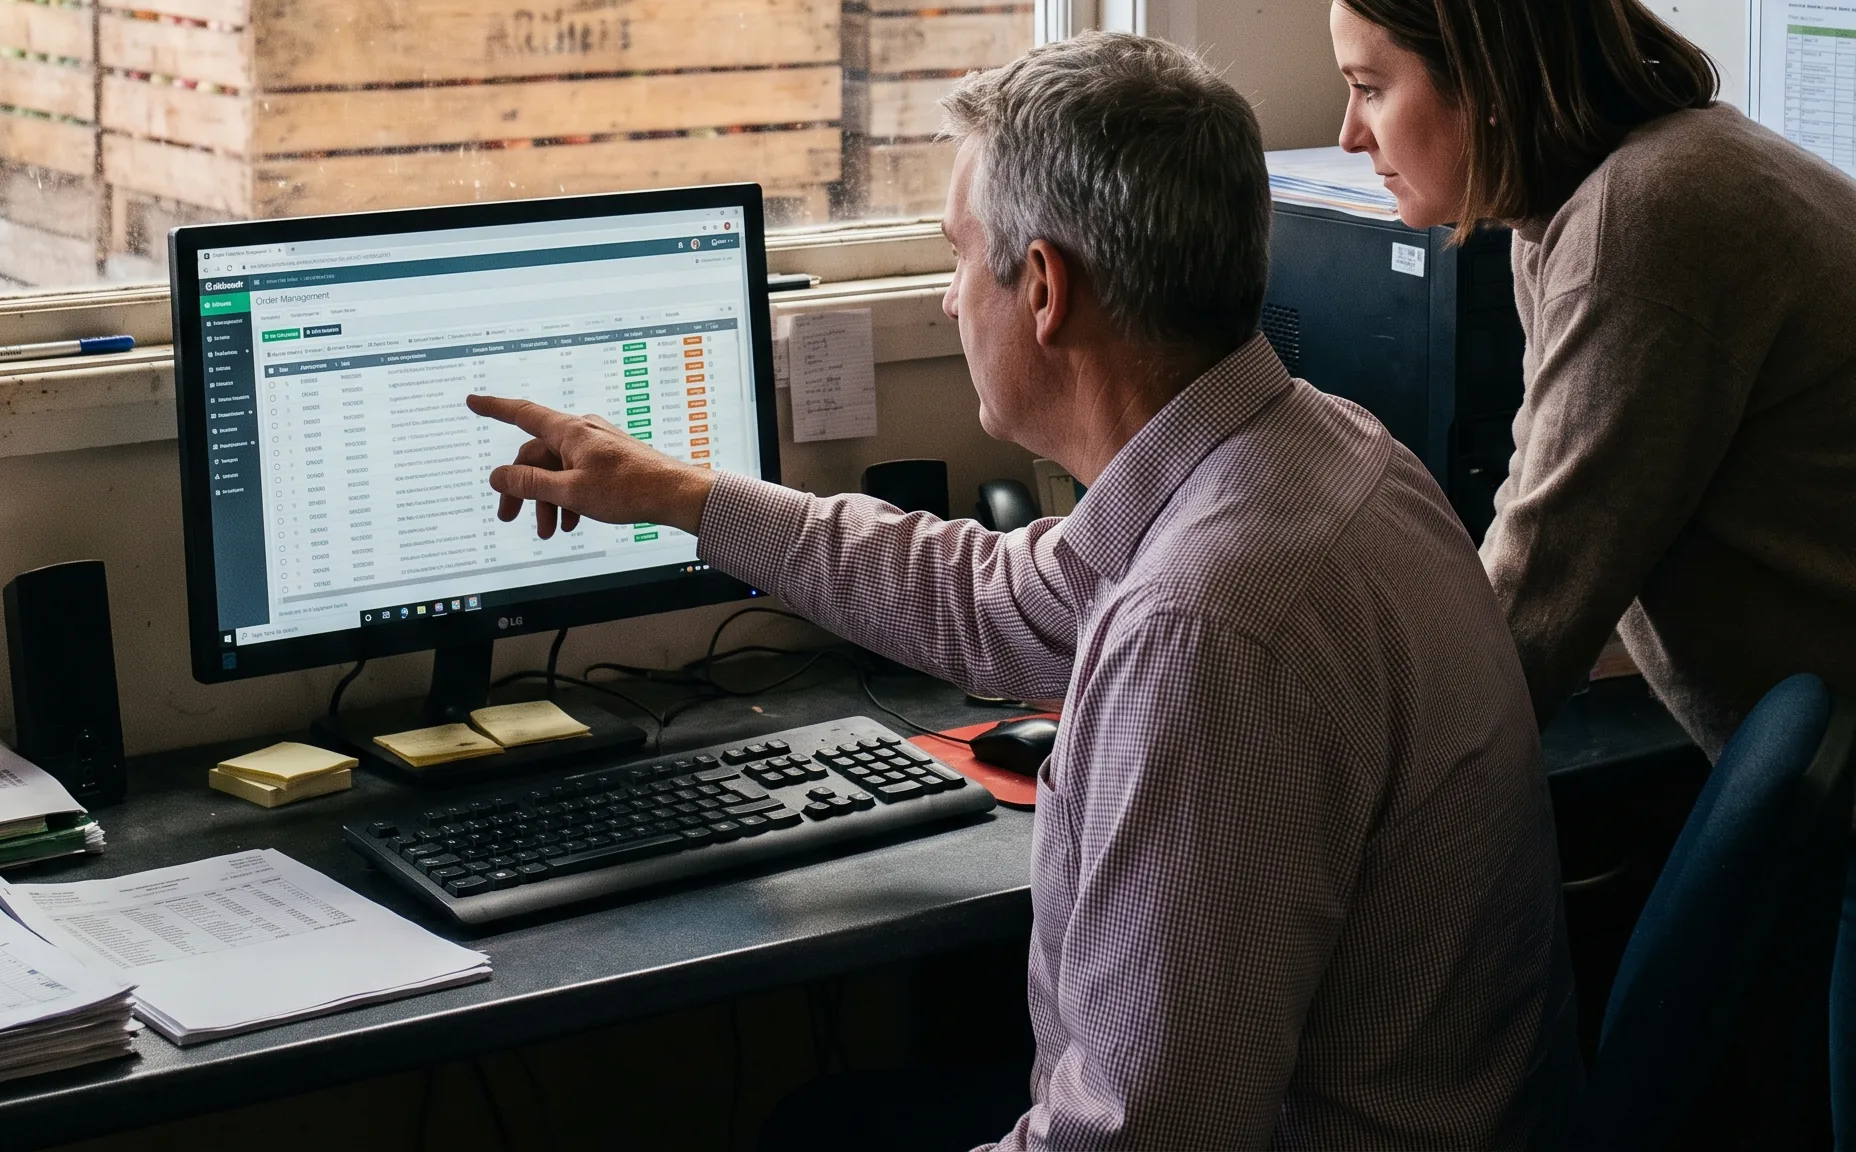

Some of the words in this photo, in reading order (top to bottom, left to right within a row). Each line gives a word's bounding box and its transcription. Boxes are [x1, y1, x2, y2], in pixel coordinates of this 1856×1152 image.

[255, 296, 279, 306] Order
[280, 292, 330, 303] Management
[510, 616, 523, 626] LG
